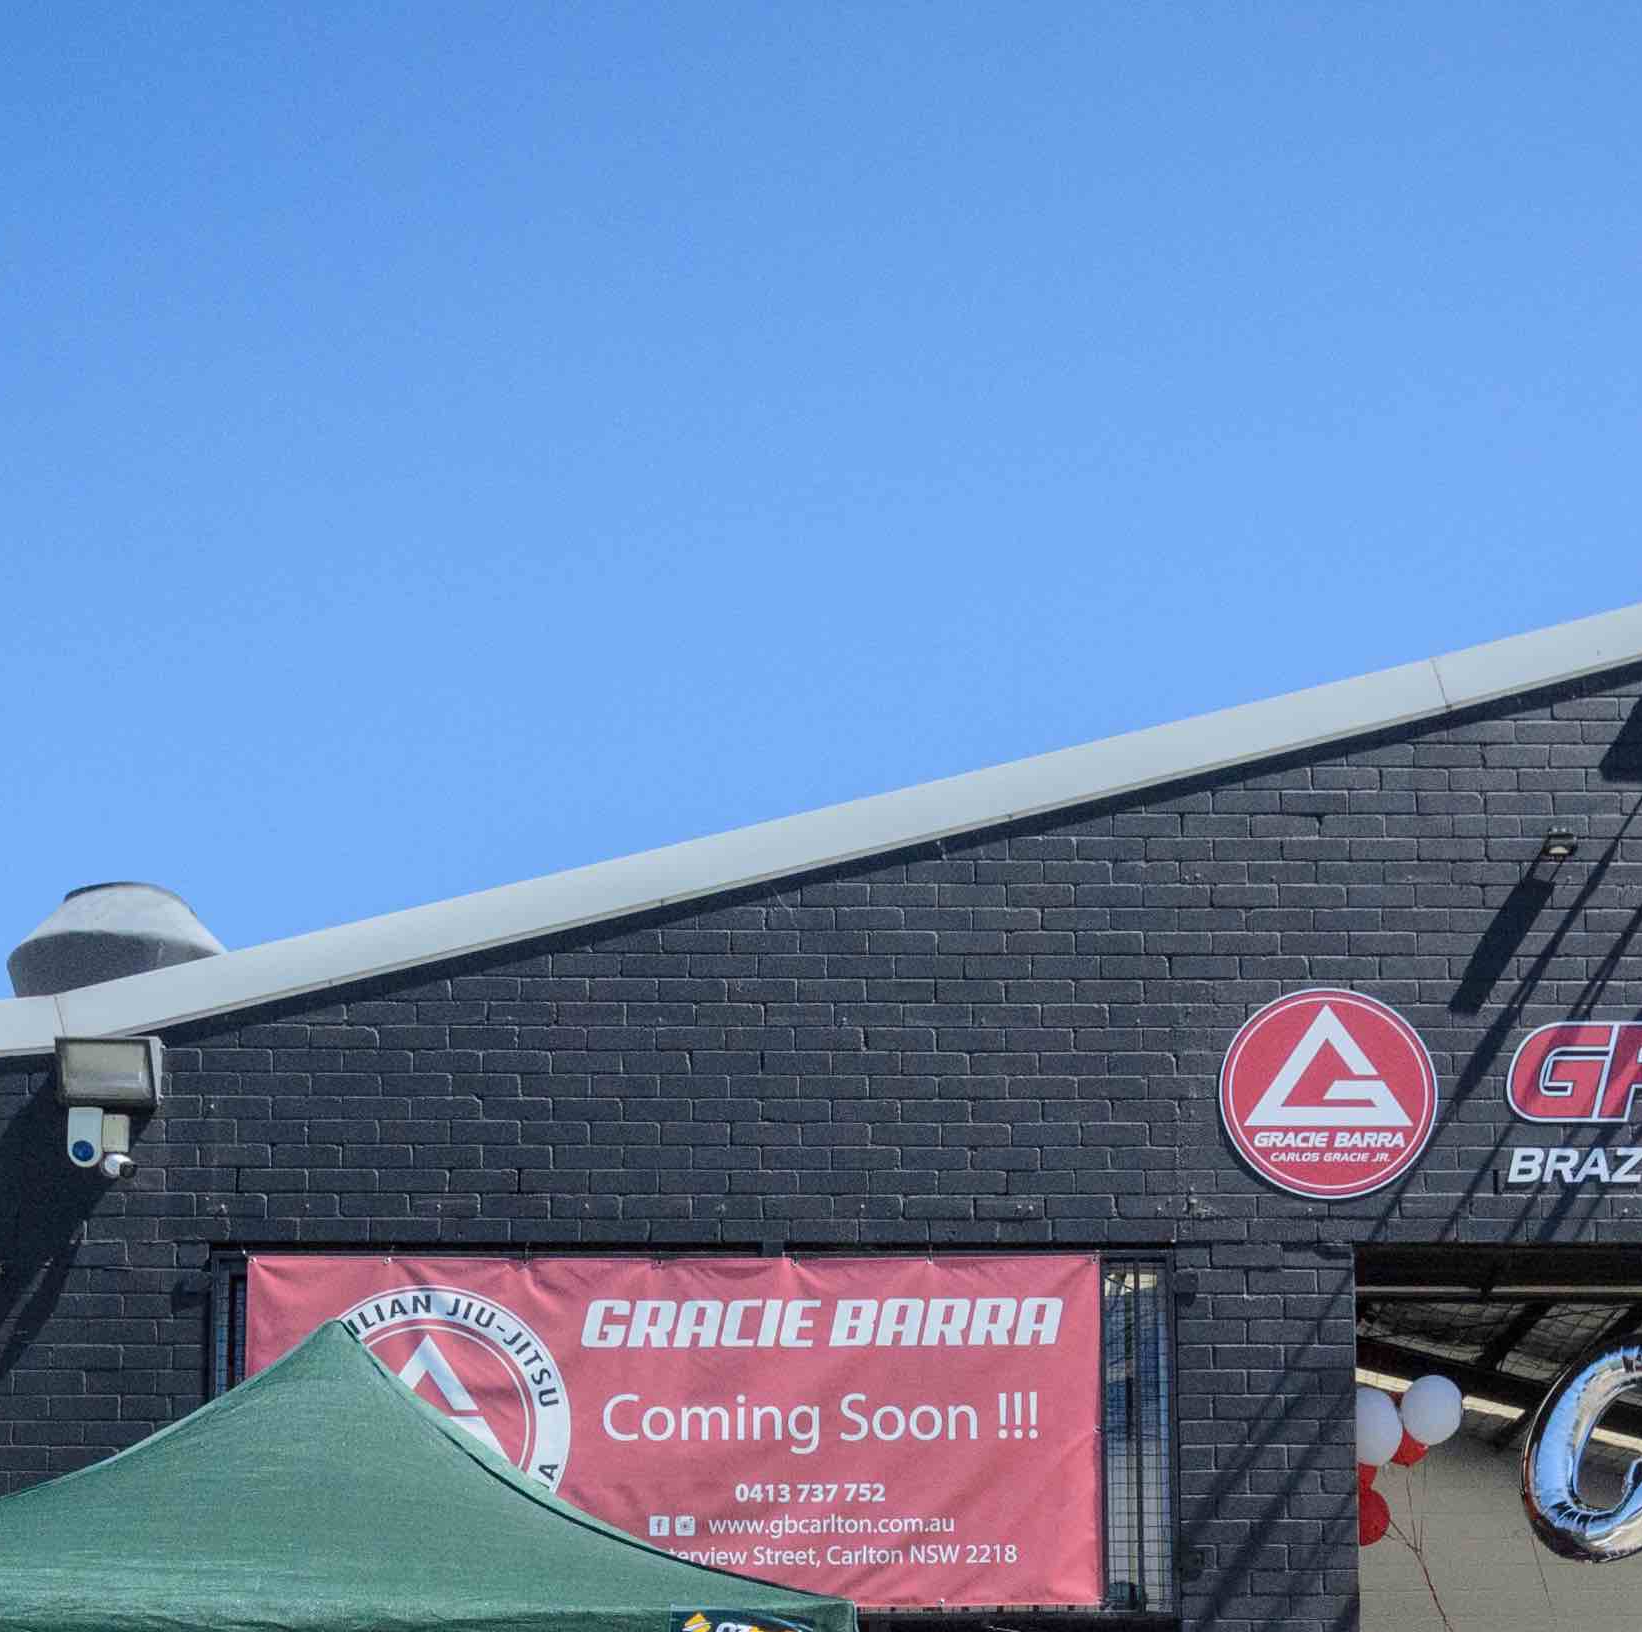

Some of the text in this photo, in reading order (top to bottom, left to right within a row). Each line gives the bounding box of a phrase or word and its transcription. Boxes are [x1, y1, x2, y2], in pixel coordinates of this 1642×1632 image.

[1253, 1132, 1405, 1148] GRACIE BARRA
[1270, 1152, 1390, 1162] CARLOS GRACIE JR.
[581, 1297, 1063, 1348] GRACIE BARRA
[446, 1298, 559, 1408] JIU-JITSU
[602, 1391, 1039, 1455] Coming Soon !!!
[735, 1483, 885, 1503] 0413 737 752
[708, 1514, 954, 1538] www.gbcarlton.com.au
[753, 1546, 821, 1568] Street,
[827, 1545, 903, 1566] Carlton
[910, 1546, 959, 1564] NSW
[966, 1545, 1018, 1564] 2218
